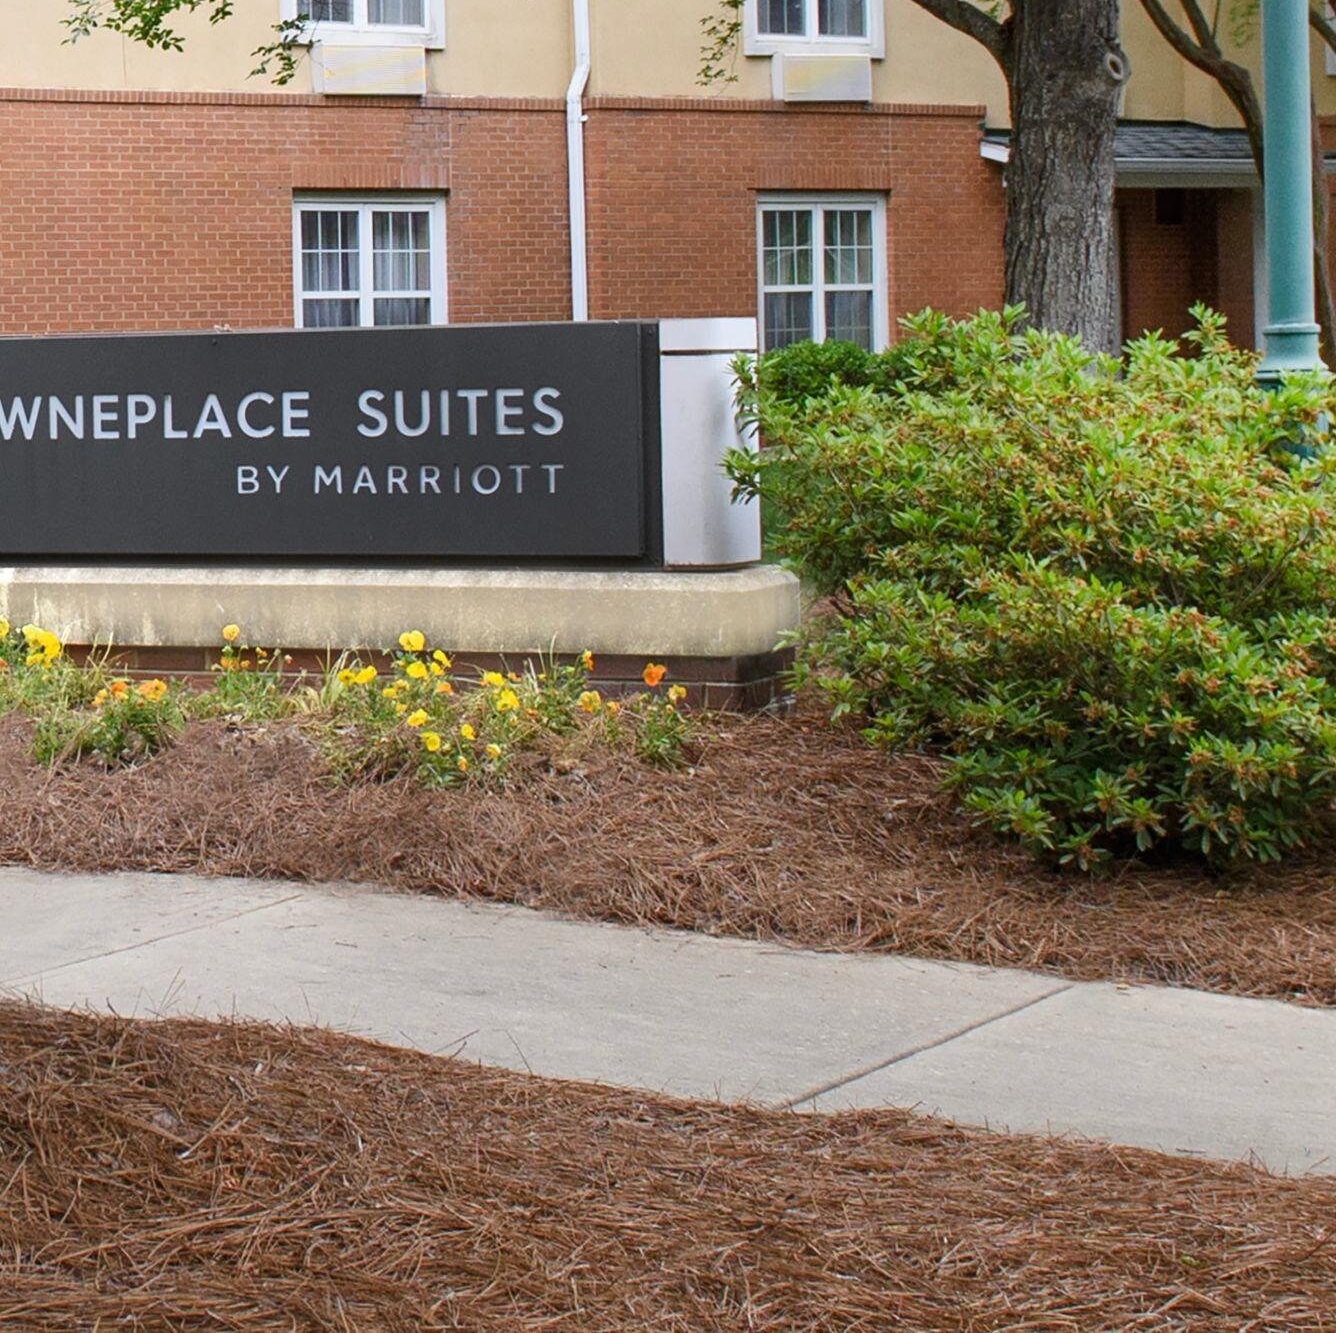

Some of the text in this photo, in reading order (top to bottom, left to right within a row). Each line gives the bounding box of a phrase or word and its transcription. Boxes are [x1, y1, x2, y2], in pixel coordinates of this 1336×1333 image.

[0, 387, 564, 440] WNEPLACE SUITES
[236, 464, 565, 495] BY MARRIOTT
